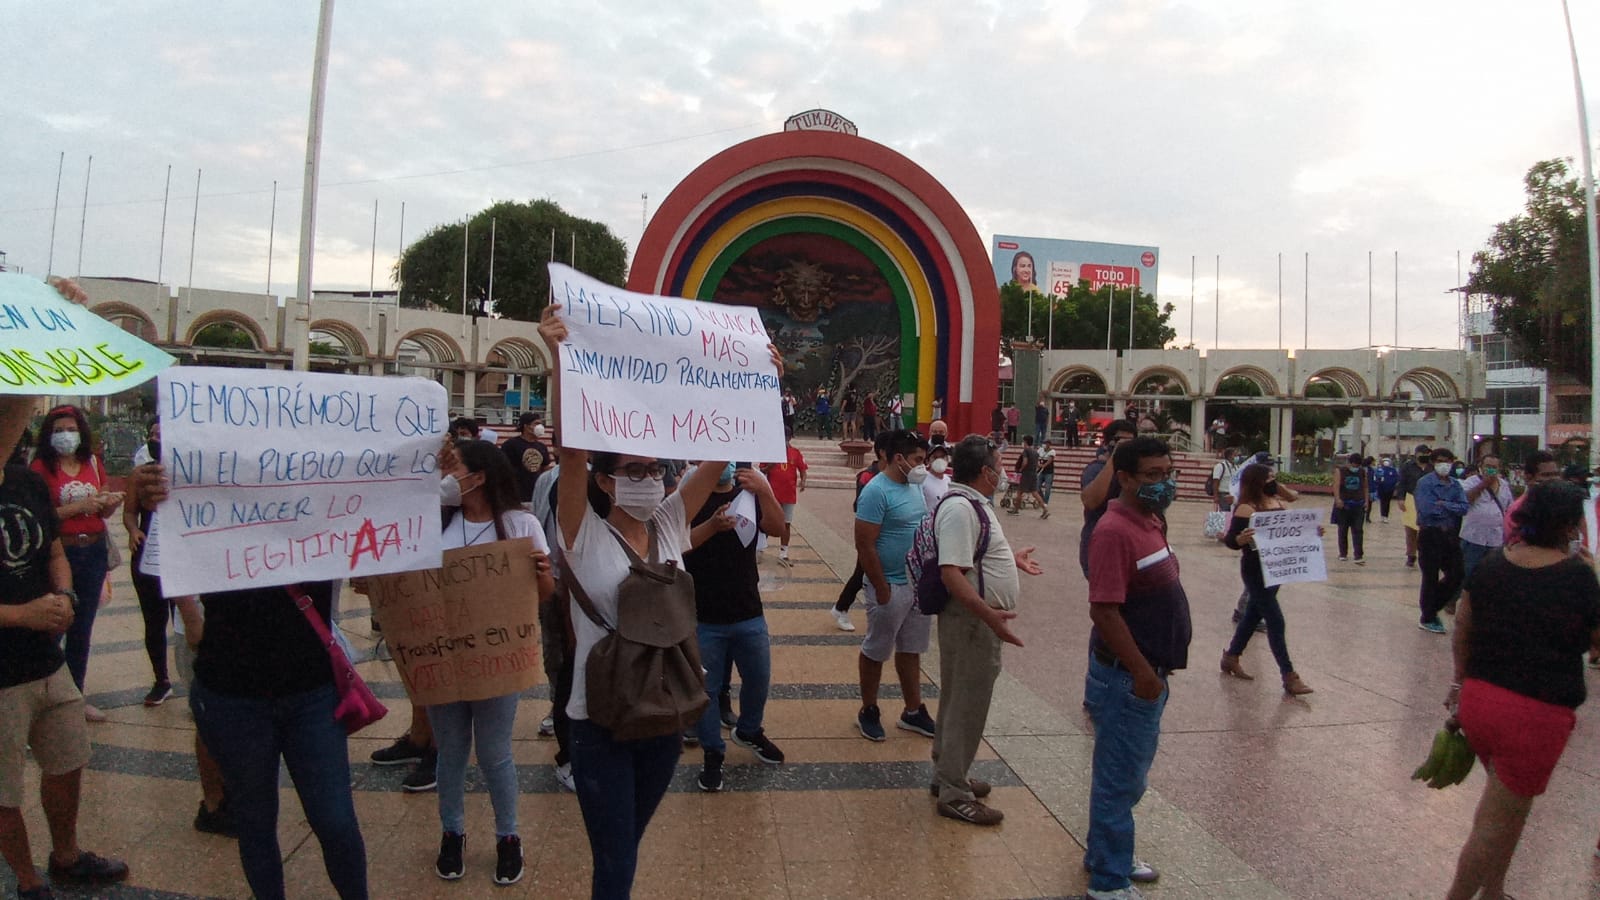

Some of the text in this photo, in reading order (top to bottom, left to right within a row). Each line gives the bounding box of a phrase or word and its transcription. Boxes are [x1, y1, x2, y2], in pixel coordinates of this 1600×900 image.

[793, 112, 851, 134] TUMBES
[1053, 280, 1071, 295] 65
[1095, 269, 1124, 282] TODO
[31, 306, 77, 332] UN
[564, 281, 764, 337] MERINO NUNCA
[701, 330, 749, 367] MÁS
[564, 343, 779, 392] INMUNIDAD PARLAMENTARIA
[170, 381, 442, 437] DEMOSTRÉMOSLE QUE
[581, 388, 756, 443] NUNCA MÁS!!!
[172, 447, 437, 487] NI EL PUEBLO QUE LO
[179, 494, 362, 529] VIO NACER LO
[1267, 525, 1303, 540] TODOS
[485, 626, 510, 647] en
[516, 622, 536, 639] un
